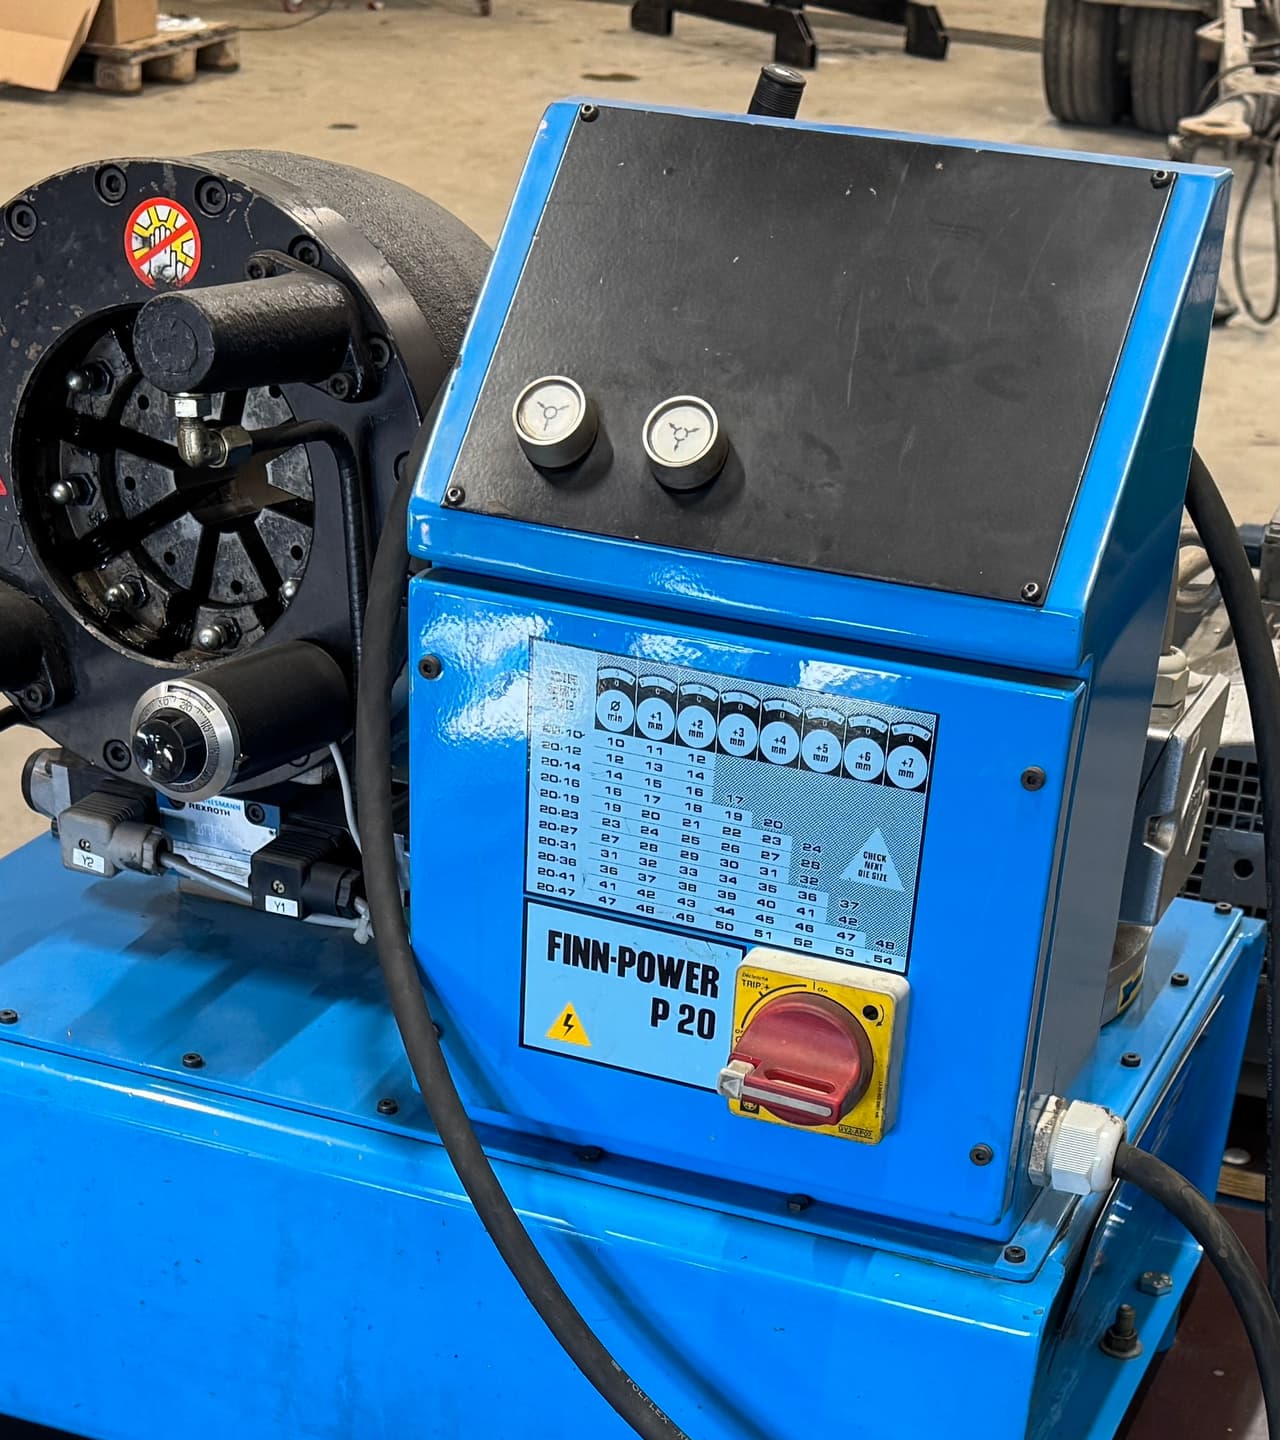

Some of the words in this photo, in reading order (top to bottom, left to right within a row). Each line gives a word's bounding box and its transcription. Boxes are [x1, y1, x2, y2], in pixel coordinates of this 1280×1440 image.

[608, 737, 625, 748] 10
[647, 745, 663, 756] 11
[688, 754, 706, 764] 12
[648, 722, 663, 731] mm
[688, 730, 704, 738] mm
[730, 738, 745, 747] mm
[772, 746, 787, 755] mm
[813, 754, 829, 763] mm
[856, 762, 871, 771] mm
[898, 769, 914, 779] mm
[651, 712, 662, 722] +1
[692, 720, 703, 730] +2
[733, 728, 744, 738] +3
[775, 736, 786, 745] +4
[816, 744, 828, 754] +5
[860, 752, 871, 762] +6
[902, 758, 914, 768] +7
[606, 770, 623, 780] 14
[645, 778, 662, 789] 15
[686, 786, 704, 797] 16
[726, 794, 744, 804] 17
[607, 754, 624, 764] 12
[646, 762, 663, 772] 13
[688, 770, 704, 780] 14
[189, 802, 231, 816] REXROTH
[605, 802, 622, 813] 19
[642, 810, 660, 821] 20
[682, 818, 700, 829] 21
[722, 826, 742, 838] 22
[762, 835, 782, 846] 23
[802, 842, 822, 853] 24
[606, 786, 622, 797] 16
[644, 794, 661, 804] 17
[685, 802, 702, 813] 18
[725, 811, 743, 822] 19
[764, 818, 784, 829] 20
[81, 855, 94, 868] Y2
[601, 834, 620, 844] 27
[640, 842, 658, 853] 28
[680, 850, 699, 861] 29
[720, 858, 739, 870] 30
[760, 867, 777, 878] 31
[800, 875, 818, 886] 32
[602, 818, 620, 829] 23
[640, 826, 659, 836] 24
[681, 834, 700, 845] 25
[721, 842, 740, 854] 26
[761, 851, 780, 861] 27
[800, 859, 820, 870] 28
[863, 851, 887, 862] CHECK
[601, 850, 618, 860] 31
[639, 858, 657, 868] 32
[679, 866, 698, 877] 33
[719, 874, 737, 885] 34
[758, 883, 777, 894] 35
[798, 891, 817, 902] 36
[840, 900, 859, 910] 37
[858, 870, 871, 880] DIE
[872, 872, 887, 882] SIZE
[864, 861, 883, 872] NEXT
[274, 901, 285, 912] Y1
[600, 865, 618, 876] 36
[638, 873, 656, 883] 37
[678, 882, 697, 893] 38
[718, 890, 736, 901] 39
[757, 899, 776, 909] 40
[796, 907, 814, 918] 41
[838, 916, 858, 926] 42
[600, 881, 616, 891] 41
[637, 889, 656, 900] 42
[677, 898, 696, 908] 43
[717, 906, 735, 916] 44
[756, 914, 774, 925] 45
[795, 923, 814, 933] 46
[837, 932, 856, 942] 47
[876, 940, 895, 950] 48
[598, 896, 616, 906] 47
[636, 904, 655, 914] 48
[676, 913, 695, 923] 49
[716, 921, 734, 932] 50
[754, 929, 772, 940] 51
[794, 938, 813, 948] 52
[835, 946, 854, 958] 53
[874, 954, 892, 965] 54
[547, 929, 720, 999] FINN-POWER
[650, 997, 670, 1028] P
[677, 1003, 717, 1041] 20
